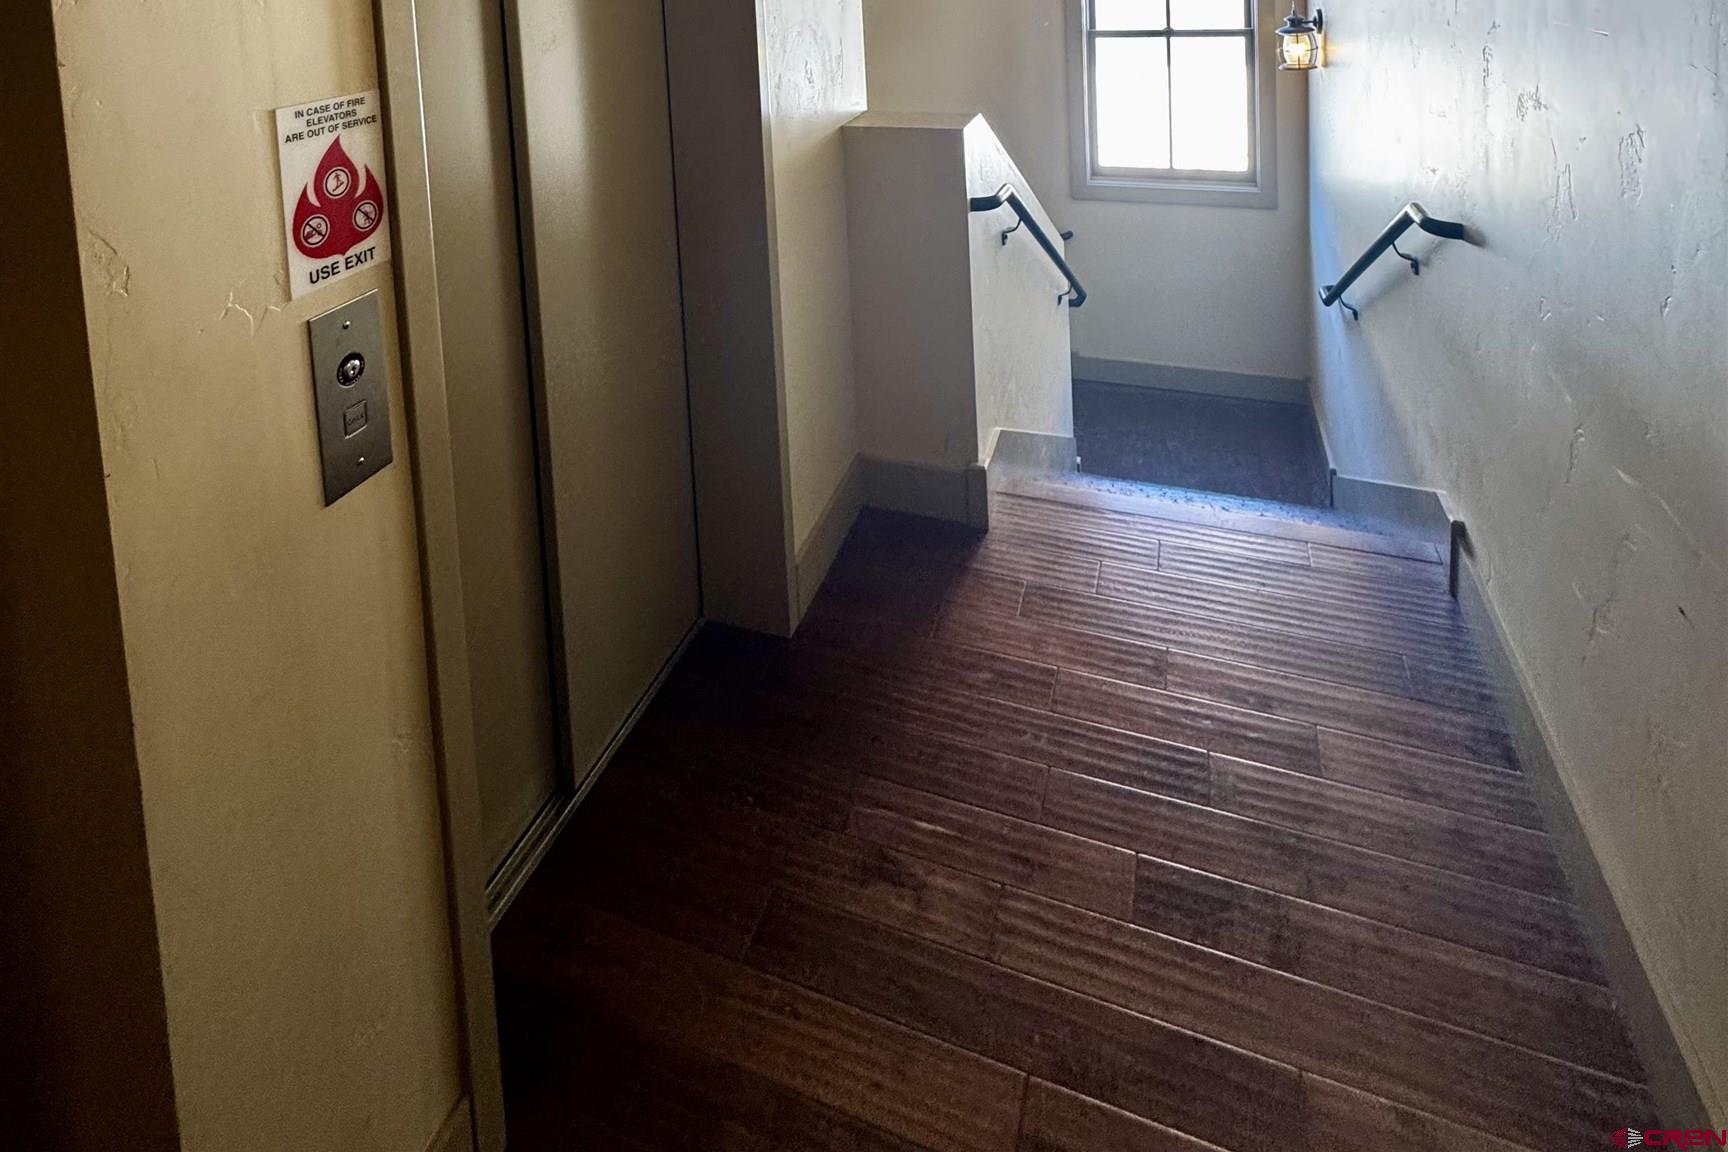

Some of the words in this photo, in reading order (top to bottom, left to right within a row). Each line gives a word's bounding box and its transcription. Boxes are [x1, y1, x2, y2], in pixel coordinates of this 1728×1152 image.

[294, 110, 304, 119] IN
[306, 104, 331, 117] CASE
[332, 101, 345, 110] OF
[347, 96, 366, 108] FIRE
[306, 109, 357, 128] ELEVATORS
[284, 132, 304, 144] ARE
[307, 127, 326, 138] OUT
[328, 124, 340, 133] OF
[342, 114, 377, 130] SERVICE
[309, 261, 341, 284] USE
[344, 246, 376, 270] EXIT
